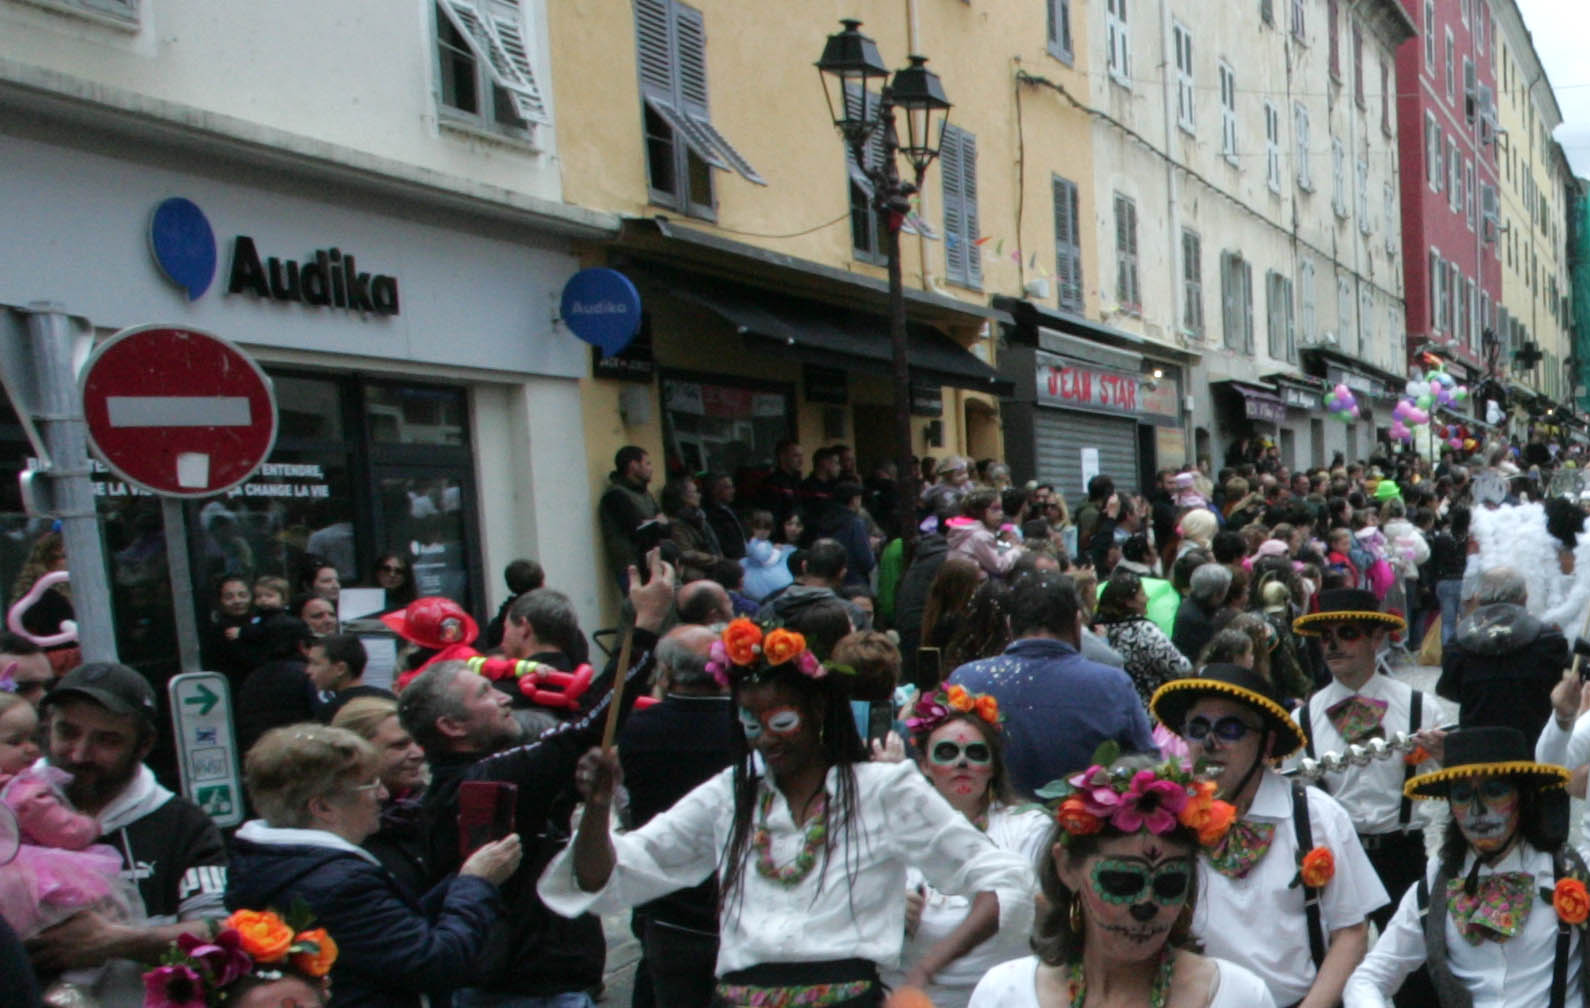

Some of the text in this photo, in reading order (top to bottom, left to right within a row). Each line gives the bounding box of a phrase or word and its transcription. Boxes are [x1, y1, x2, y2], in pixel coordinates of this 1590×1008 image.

[228, 234, 399, 316] Audika
[571, 301, 627, 315] Audika
[1047, 365, 1093, 402] JEAN
[1101, 374, 1137, 413] STAR
[245, 483, 293, 497] CHANGE
[294, 484, 310, 497] LA
[310, 484, 329, 497] VIE
